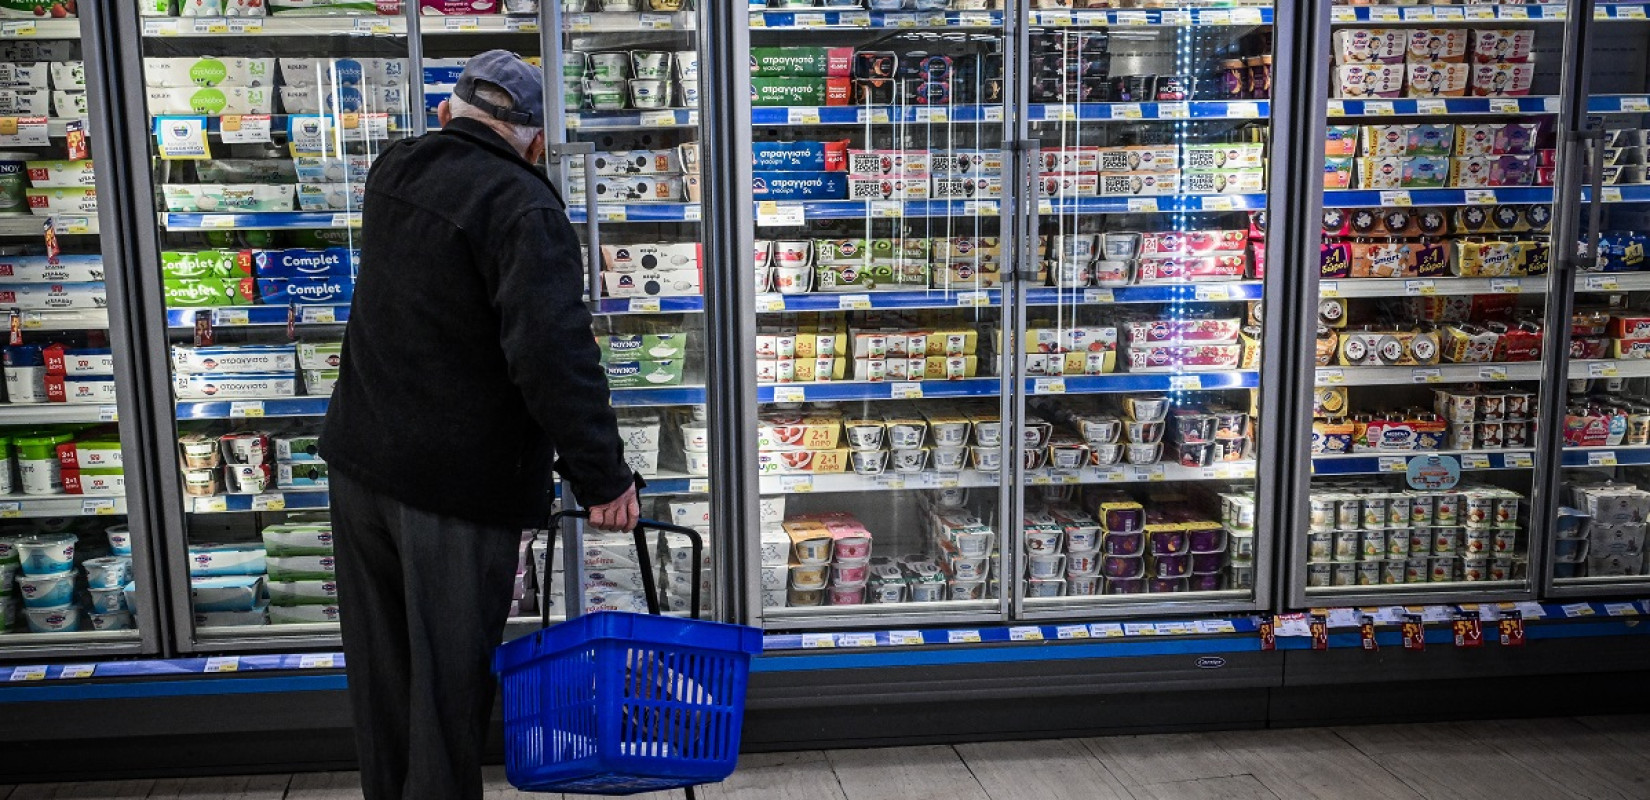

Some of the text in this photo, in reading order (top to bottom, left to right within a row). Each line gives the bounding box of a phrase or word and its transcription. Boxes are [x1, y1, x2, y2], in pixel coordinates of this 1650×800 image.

[283, 254, 339, 269] Complet
[1374, 254, 1400, 265] smart
[1484, 254, 1510, 264] smart
[287, 283, 342, 297] Complet
[812, 430, 829, 440] 2+1
[821, 454, 837, 465] 2+1
[1454, 620, 1473, 635] -5%
[1500, 619, 1517, 634] -5%
